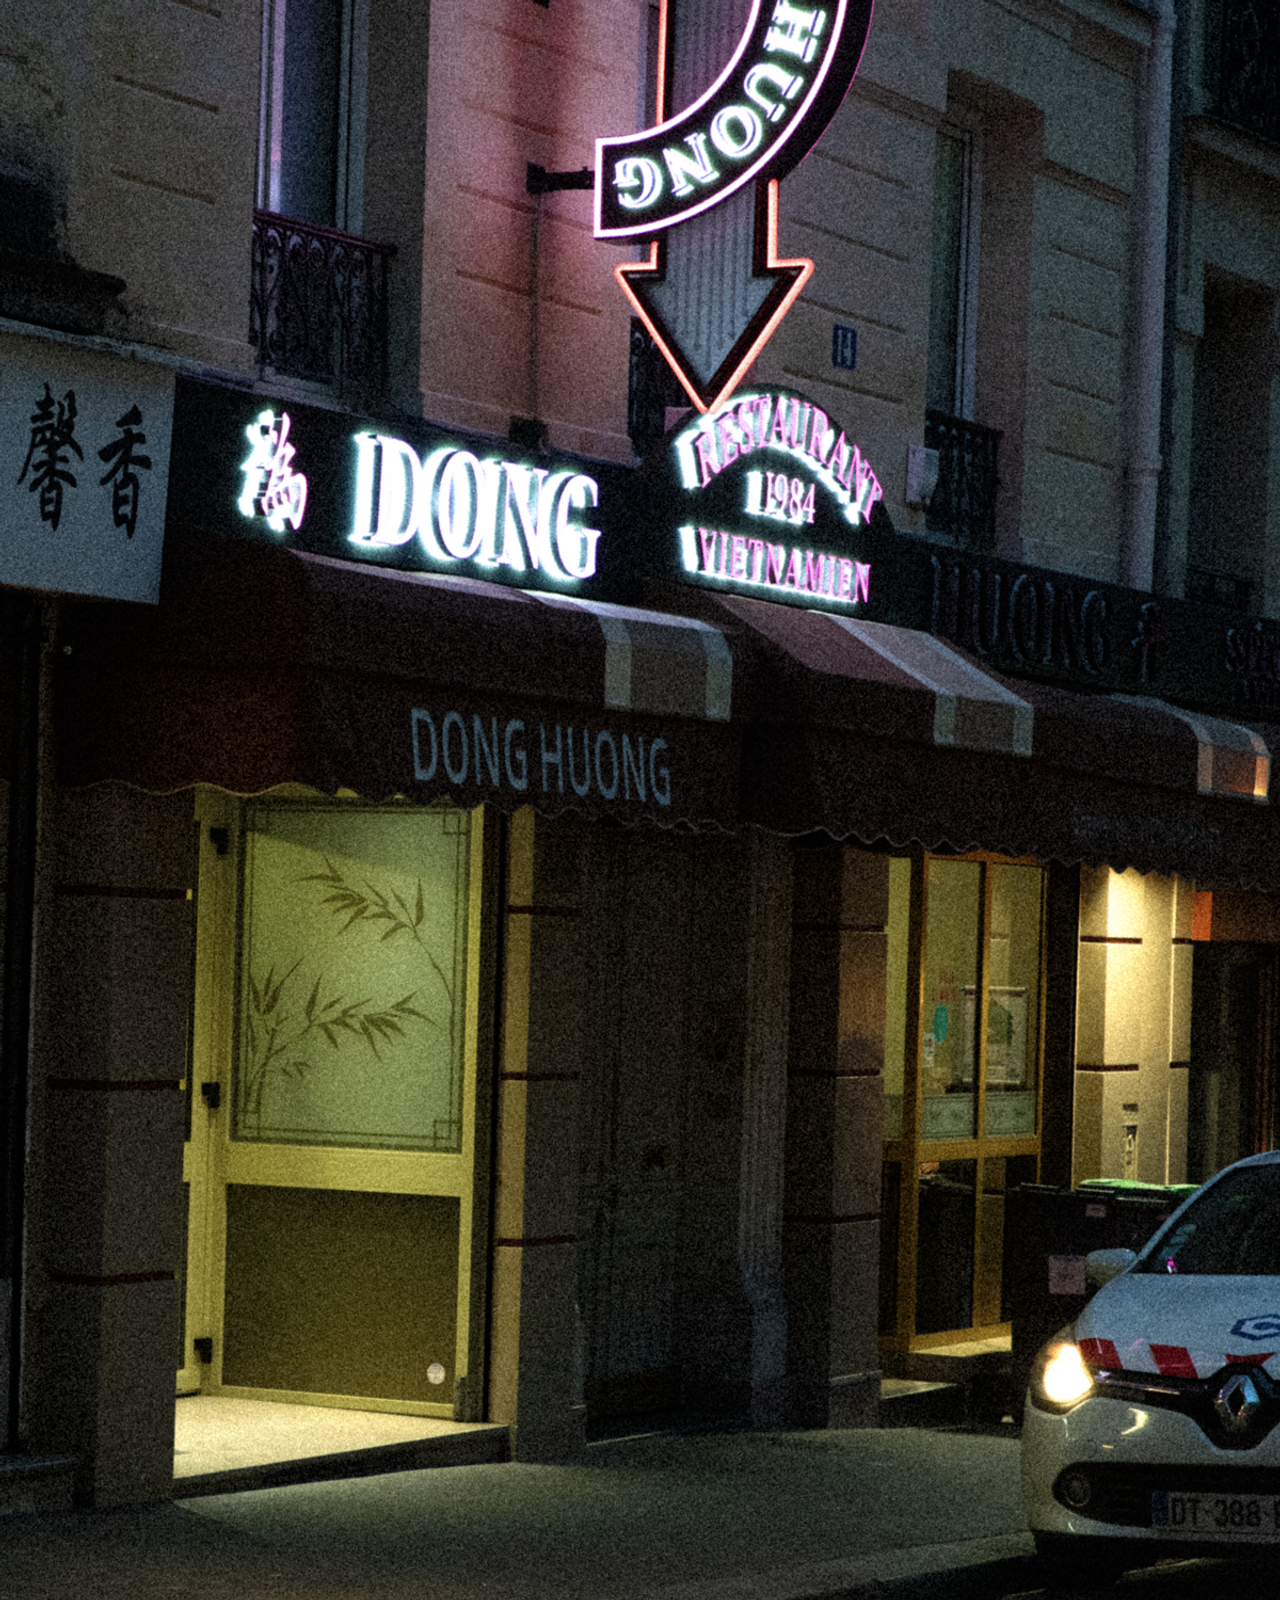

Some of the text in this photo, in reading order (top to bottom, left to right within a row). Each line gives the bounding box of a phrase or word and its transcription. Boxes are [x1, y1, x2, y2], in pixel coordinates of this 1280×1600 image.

[612, 0, 827, 209] HUONG
[348, 433, 601, 581] DONG
[676, 394, 884, 525] RESTAURANT
[745, 470, 817, 525] 1984
[679, 525, 872, 603] VIETNAMIEN
[930, 554, 1114, 676] HUONG
[411, 706, 673, 807] DONG HUONG
